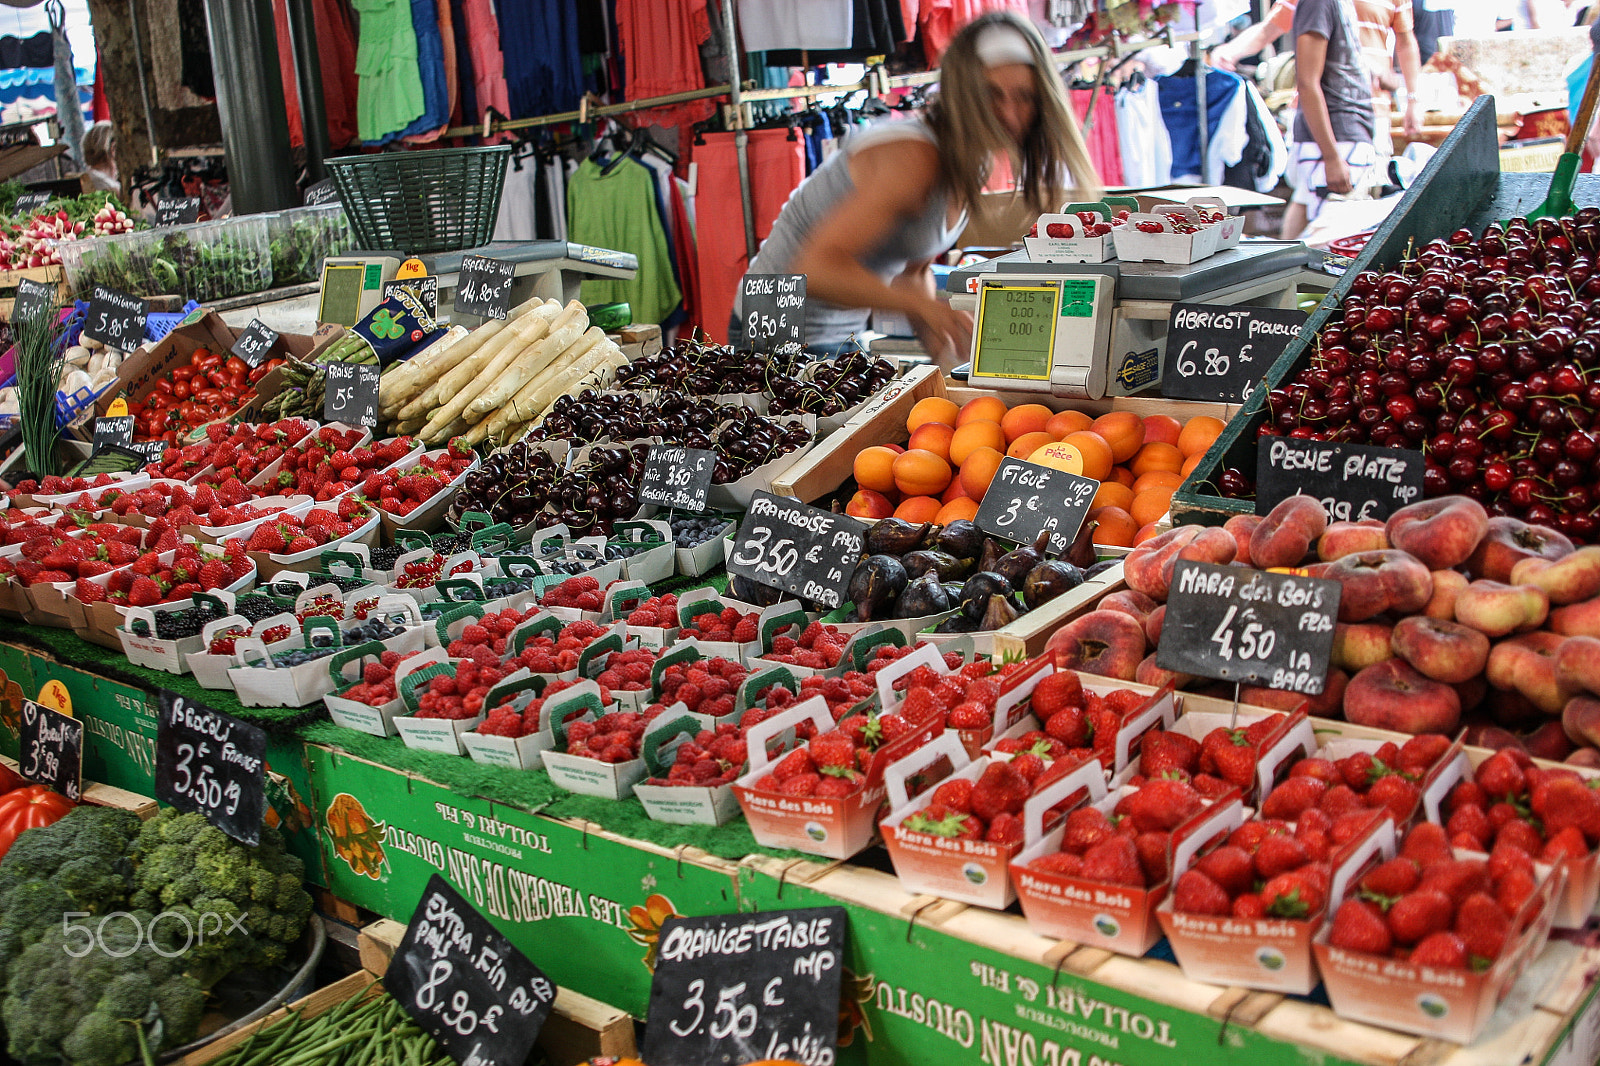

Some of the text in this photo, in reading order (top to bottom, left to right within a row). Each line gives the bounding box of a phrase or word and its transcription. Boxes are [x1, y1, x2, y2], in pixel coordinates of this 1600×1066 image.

[405, 263, 420, 273] 1kg
[745, 278, 776, 296] CERISE
[1006, 291, 1036, 303] 0.215
[1174, 308, 1250, 330] ABRICOT
[328, 363, 354, 380] FRAISE
[1176, 340, 1231, 378] 6.80
[1269, 440, 1333, 473] PECHE
[1002, 464, 1051, 490] FIGUE
[750, 498, 835, 535] FRAMBOISE
[1179, 566, 1236, 598] MARA
[435, 800, 553, 855] TOLLARI & Fils
[463, 832, 523, 860] PRODUCTEUR
[387, 825, 627, 930] LES VERGERS DE SAN GIUSTU
[970, 960, 1012, 994] Fils
[668, 978, 758, 1040] 3.50
[875, 979, 976, 1049] GIUSTU
[1046, 983, 1177, 1048] TOLLARI
